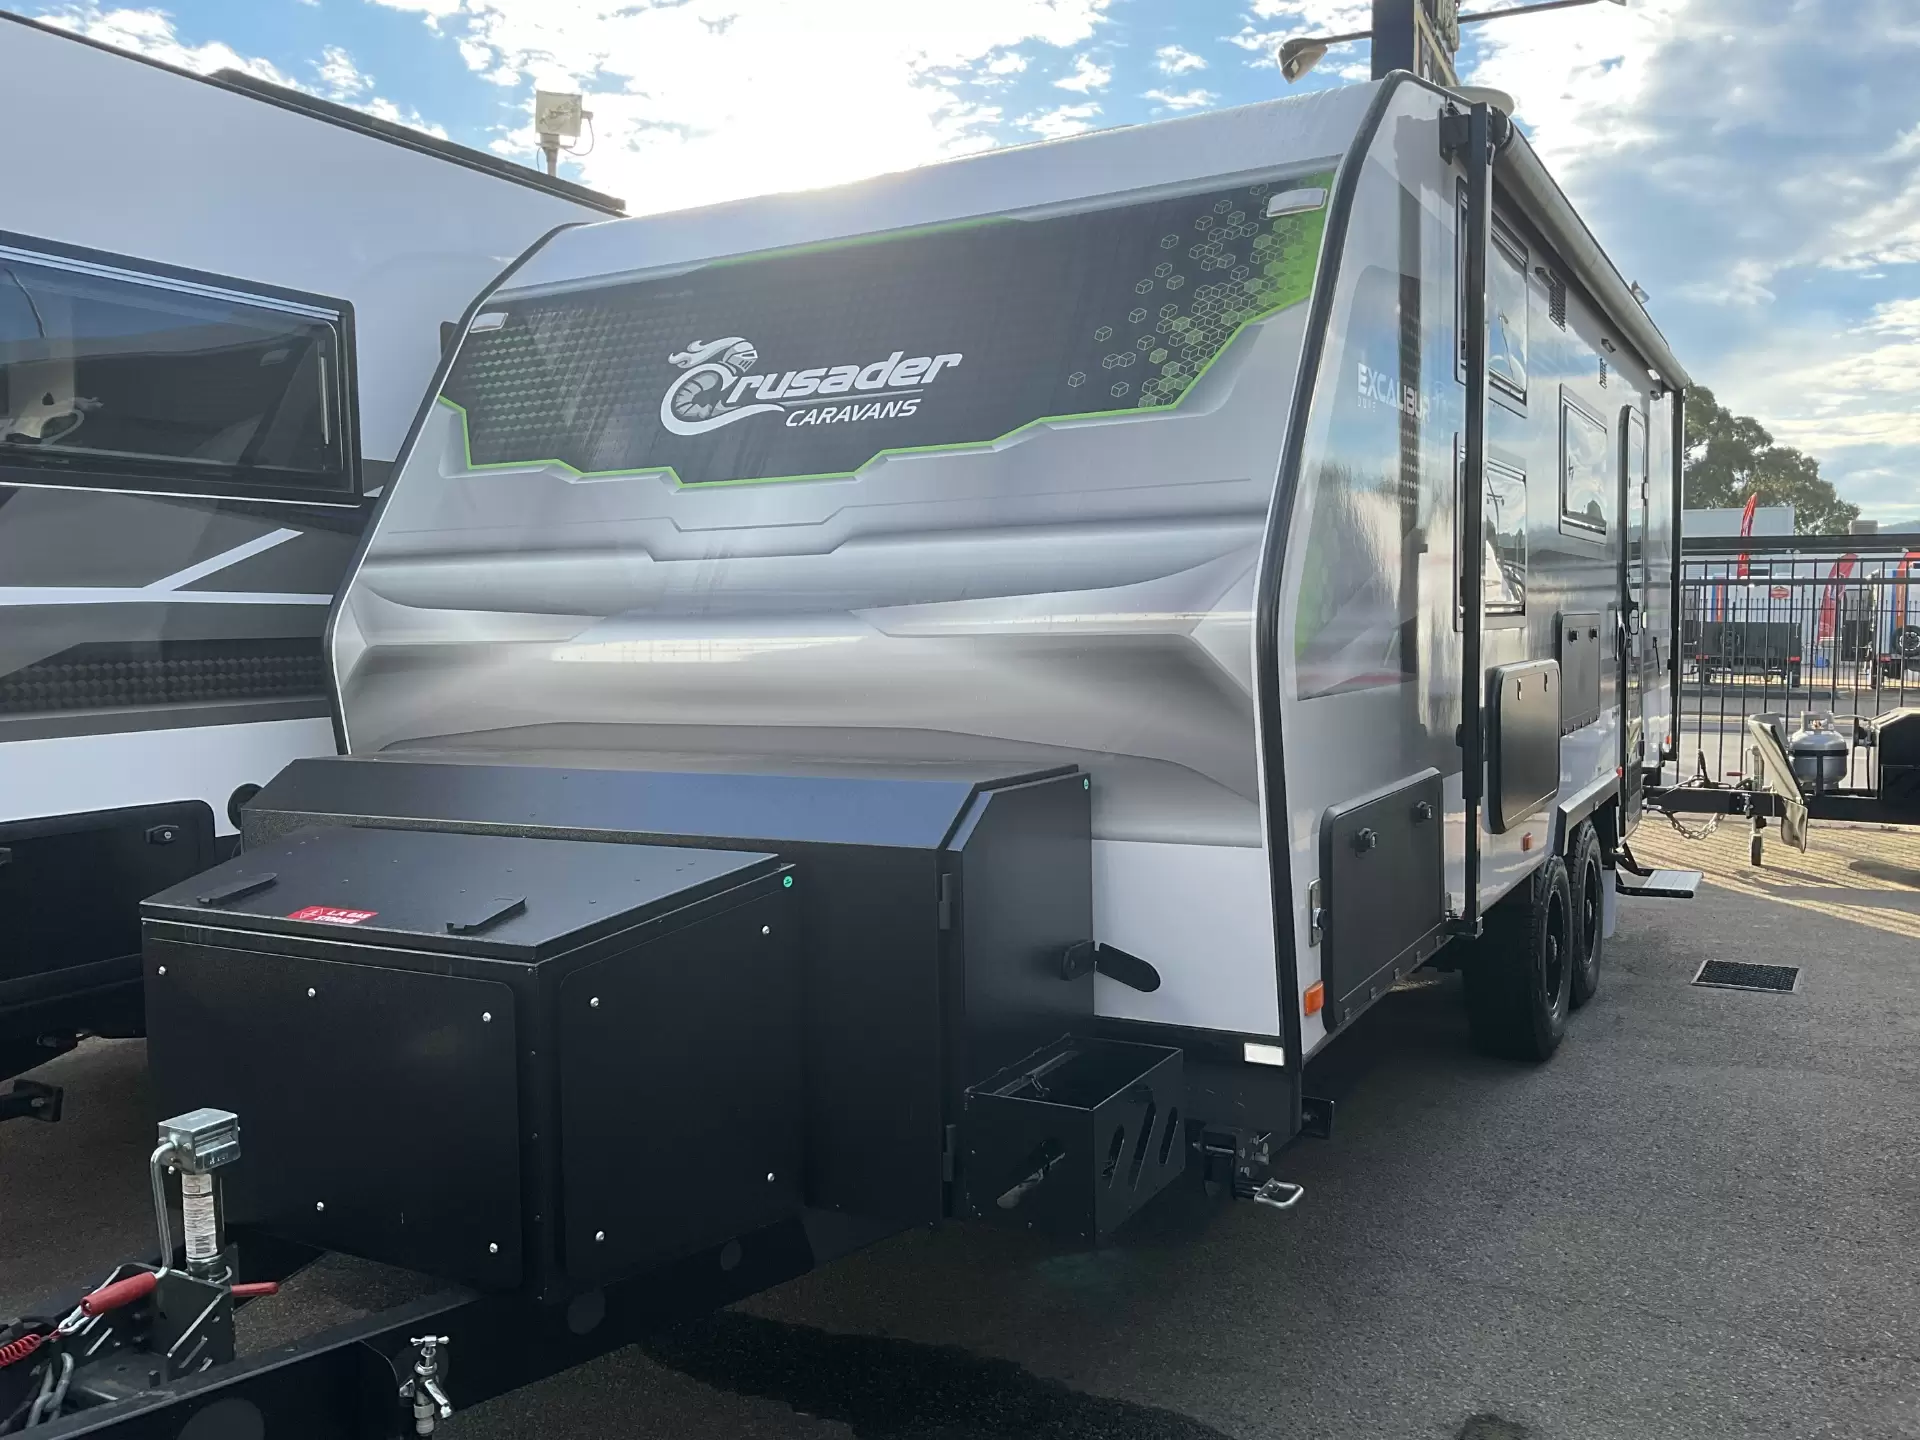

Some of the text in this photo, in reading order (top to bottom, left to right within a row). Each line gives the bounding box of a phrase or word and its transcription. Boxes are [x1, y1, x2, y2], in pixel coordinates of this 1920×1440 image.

[660, 350, 963, 435] Crusader
[785, 398, 922, 427] CARAVANS
[1357, 362, 1431, 425] EXCALIBUR
